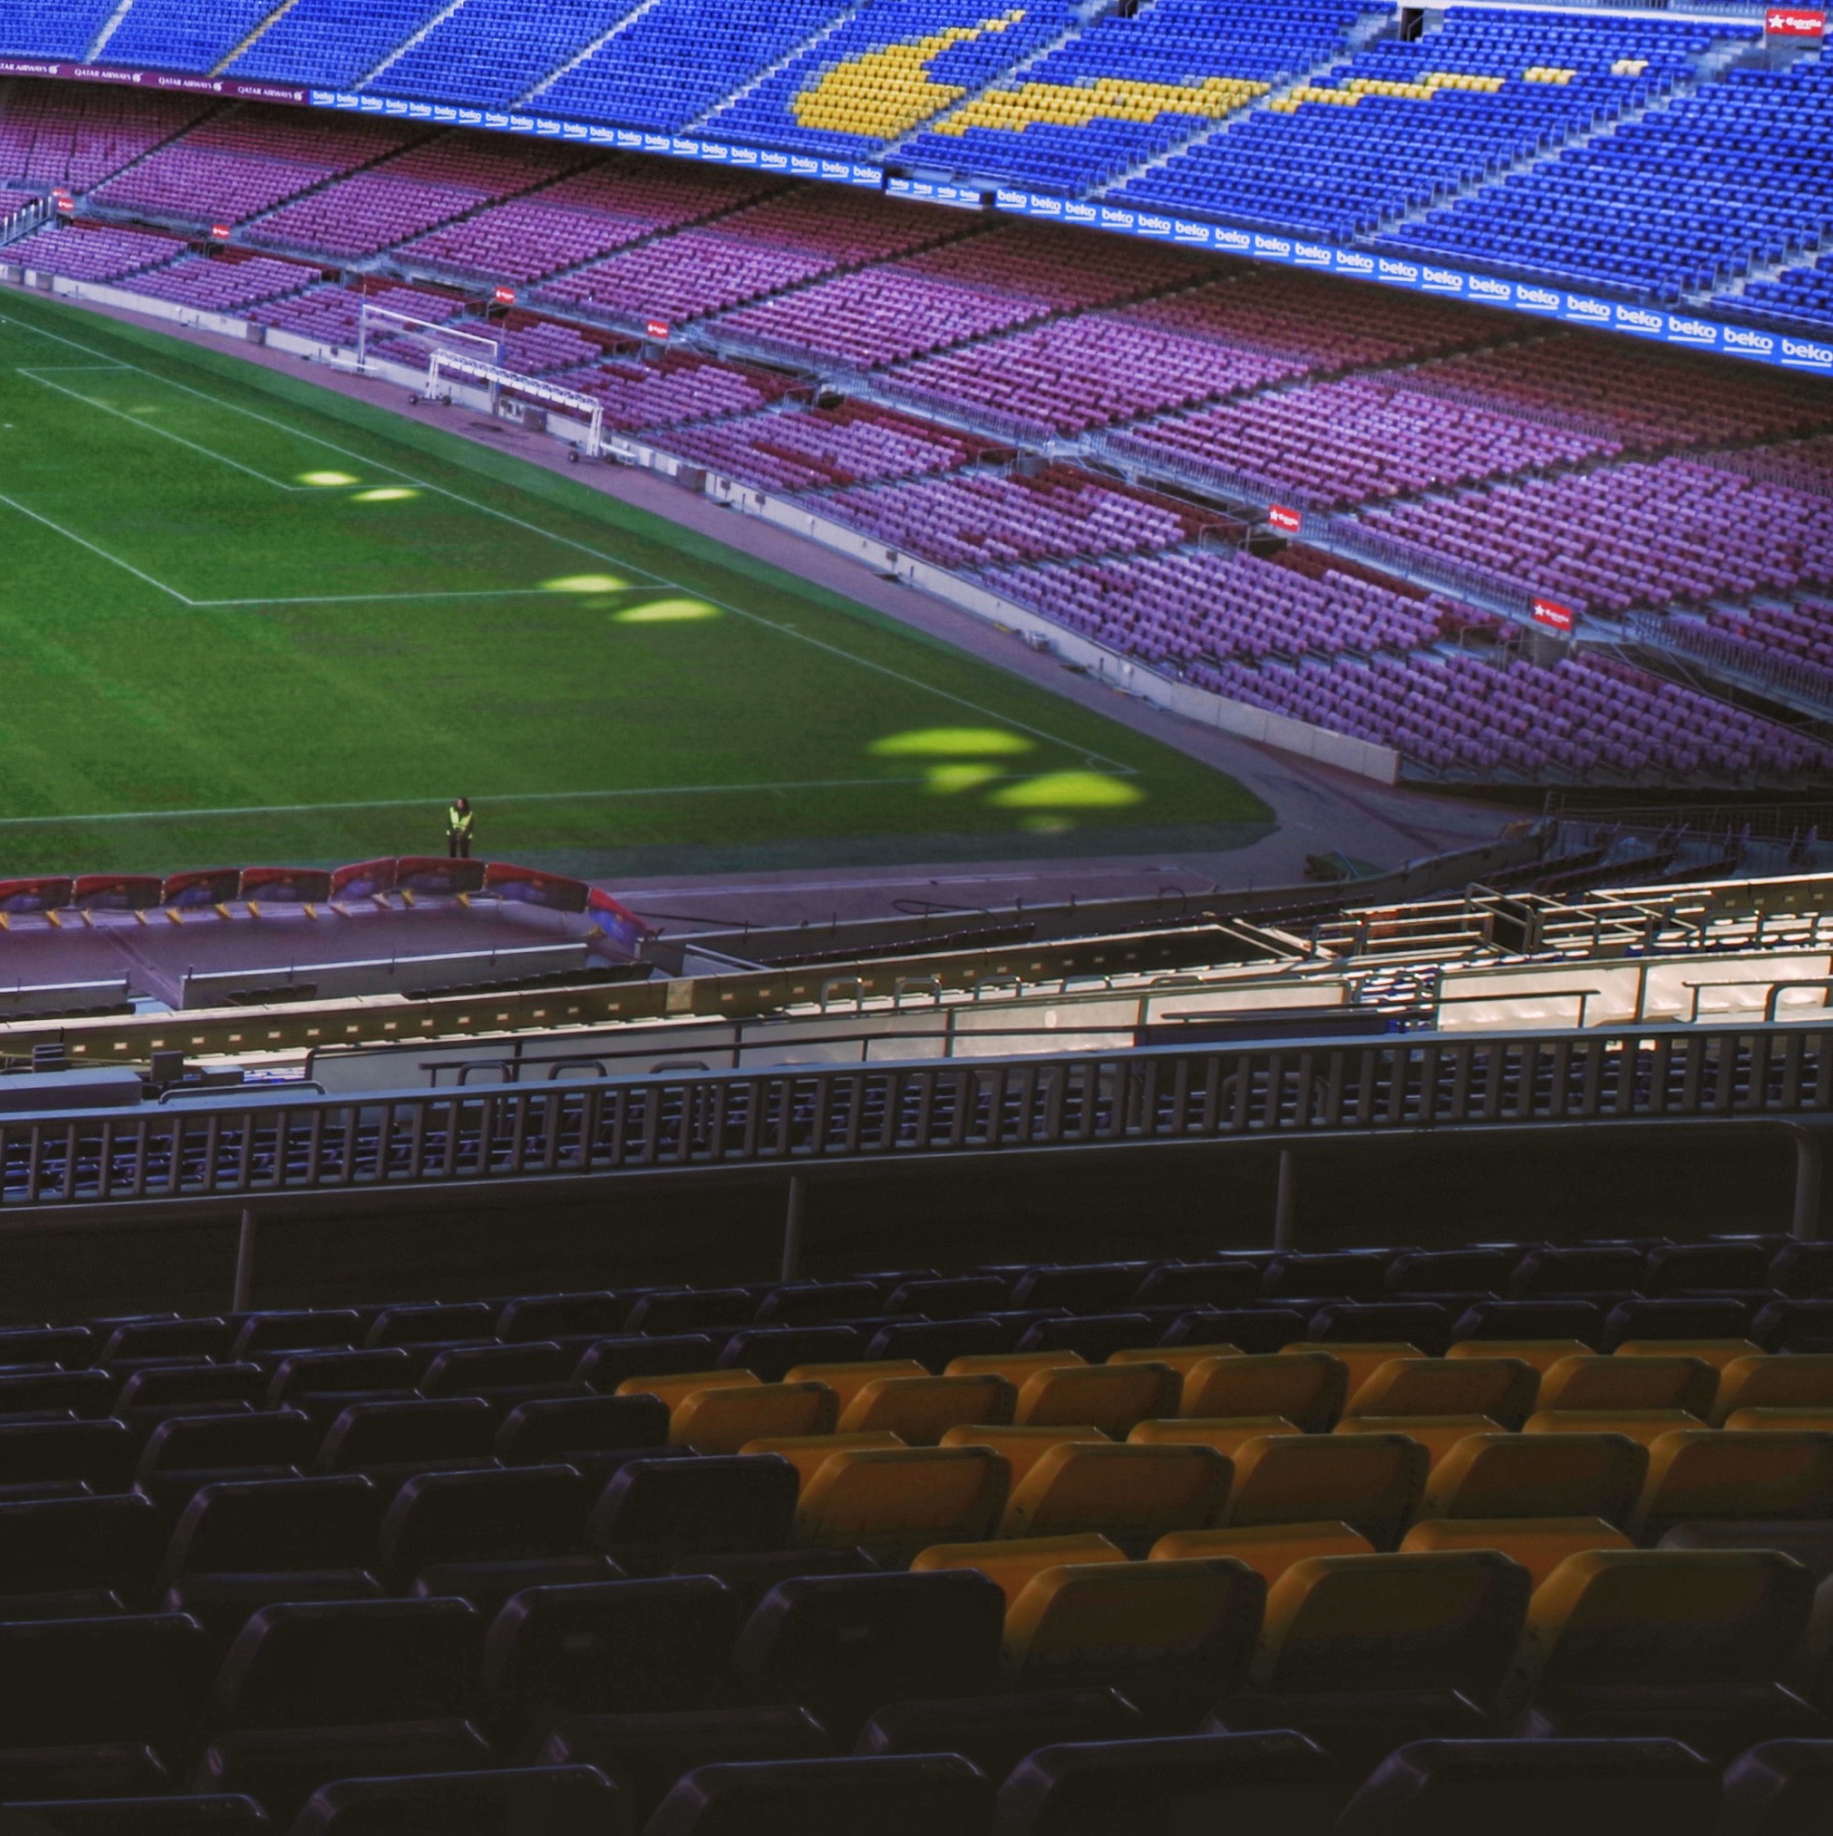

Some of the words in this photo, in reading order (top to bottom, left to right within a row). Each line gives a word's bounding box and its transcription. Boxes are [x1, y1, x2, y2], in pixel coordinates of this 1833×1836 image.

[313, 91, 334, 102] beko
[337, 93, 357, 105] beko
[361, 96, 383, 108] beko
[386, 100, 407, 111] beko
[410, 102, 431, 114] beko
[435, 106, 456, 117] beko
[459, 109, 481, 121] beko
[485, 112, 507, 124] beko
[511, 115, 533, 128] beko
[537, 119, 559, 131] beko
[564, 122, 586, 135] beko
[590, 125, 613, 138] beko
[617, 130, 641, 143] beko
[645, 134, 669, 147] beko
[673, 139, 698, 151] beko
[702, 142, 727, 155] beko
[732, 146, 757, 160] beko
[761, 150, 787, 165] beko
[791, 155, 817, 170] beko
[822, 160, 849, 175] beko
[853, 164, 881, 180] beko
[997, 188, 1026, 205] beko
[1031, 195, 1061, 211] beko
[1065, 201, 1095, 217] beko
[1102, 207, 1133, 223] beko
[1139, 214, 1171, 231] beko
[1175, 221, 1209, 237] beko
[1215, 228, 1250, 245] beko
[1255, 235, 1290, 253] beko
[1295, 242, 1331, 260] beko
[1337, 250, 1373, 268] beko
[1379, 258, 1417, 277] beko
[1423, 266, 1462, 286] beko
[1469, 275, 1511, 295] beko
[1517, 284, 1559, 304] beko
[1567, 295, 1611, 315] beko
[1616, 305, 1662, 327] beko
[1669, 316, 1716, 338] beko
[1724, 326, 1773, 349] beko
[1782, 338, 1833, 362] beko
